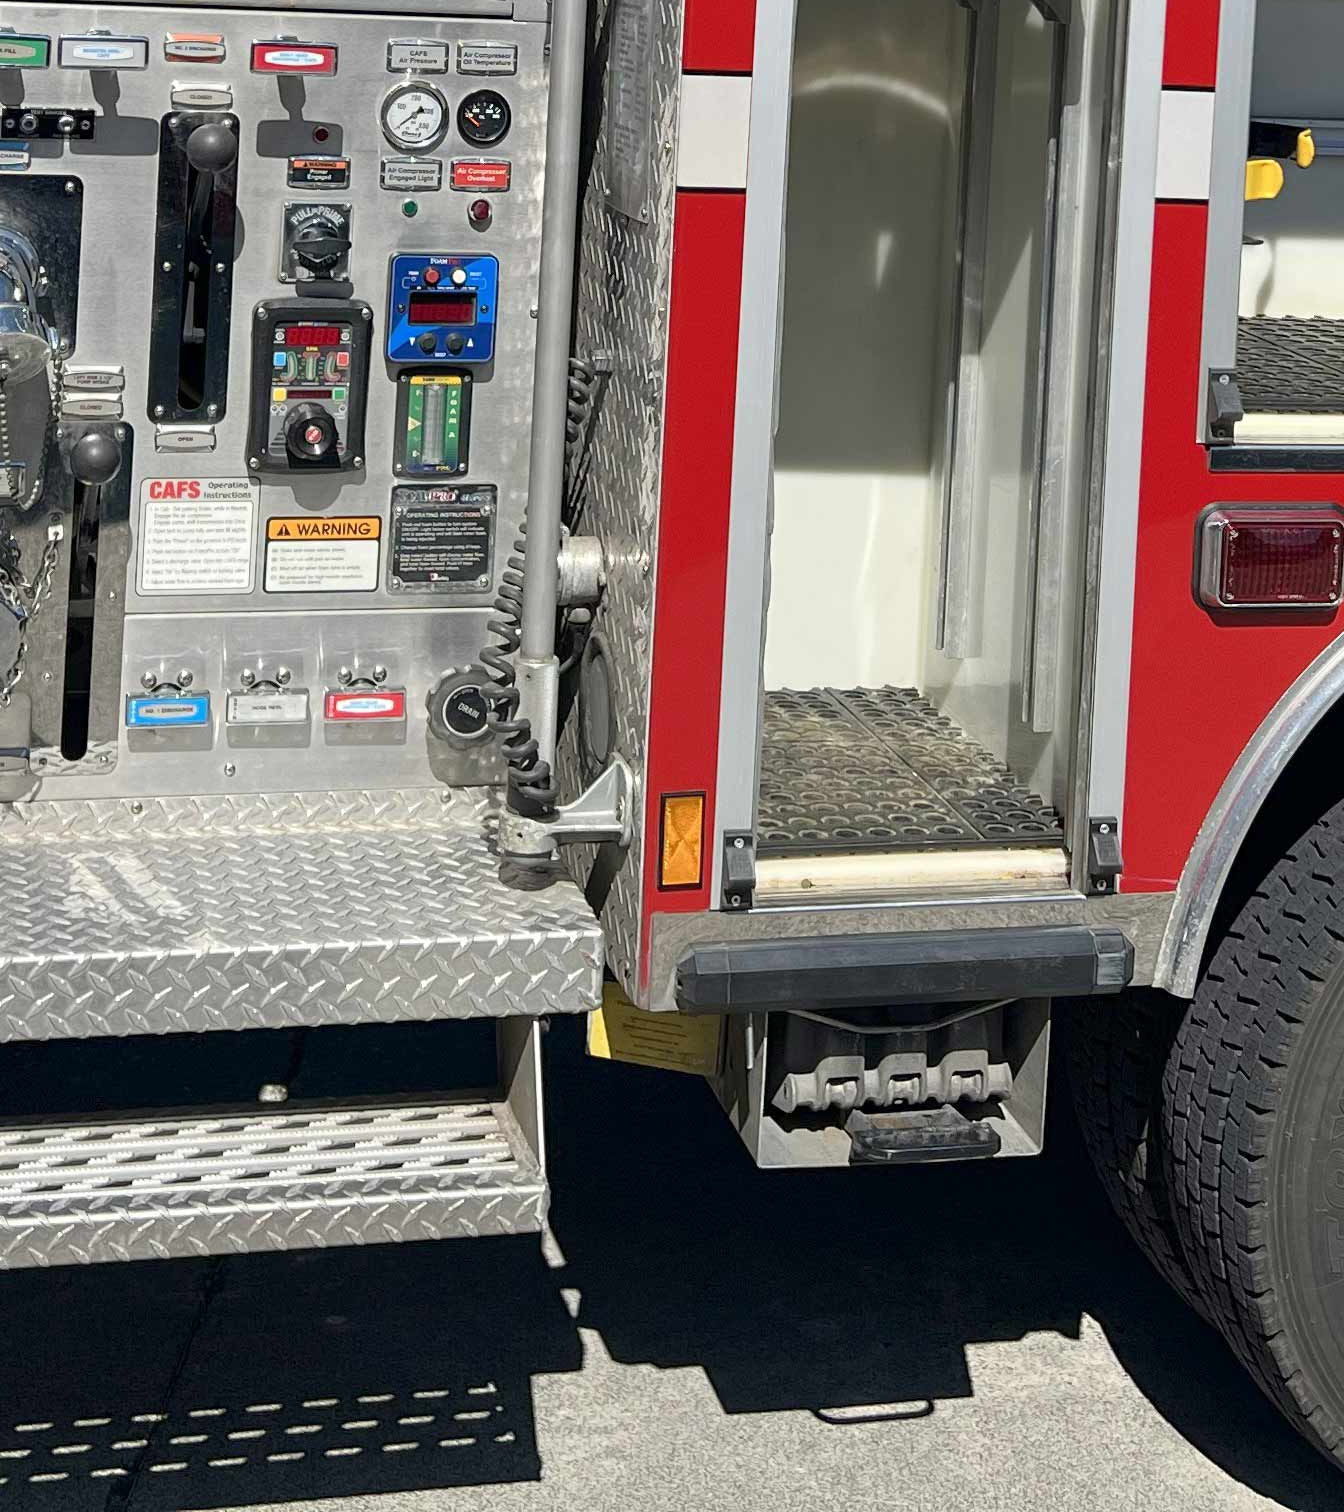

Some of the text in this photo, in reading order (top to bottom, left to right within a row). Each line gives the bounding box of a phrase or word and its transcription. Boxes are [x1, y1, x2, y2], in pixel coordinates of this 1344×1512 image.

[290, 206, 345, 226] PULL PRIME
[149, 481, 201, 499] CAFS
[297, 522, 371, 535] WARNING
[457, 702, 480, 719] DRAIN
